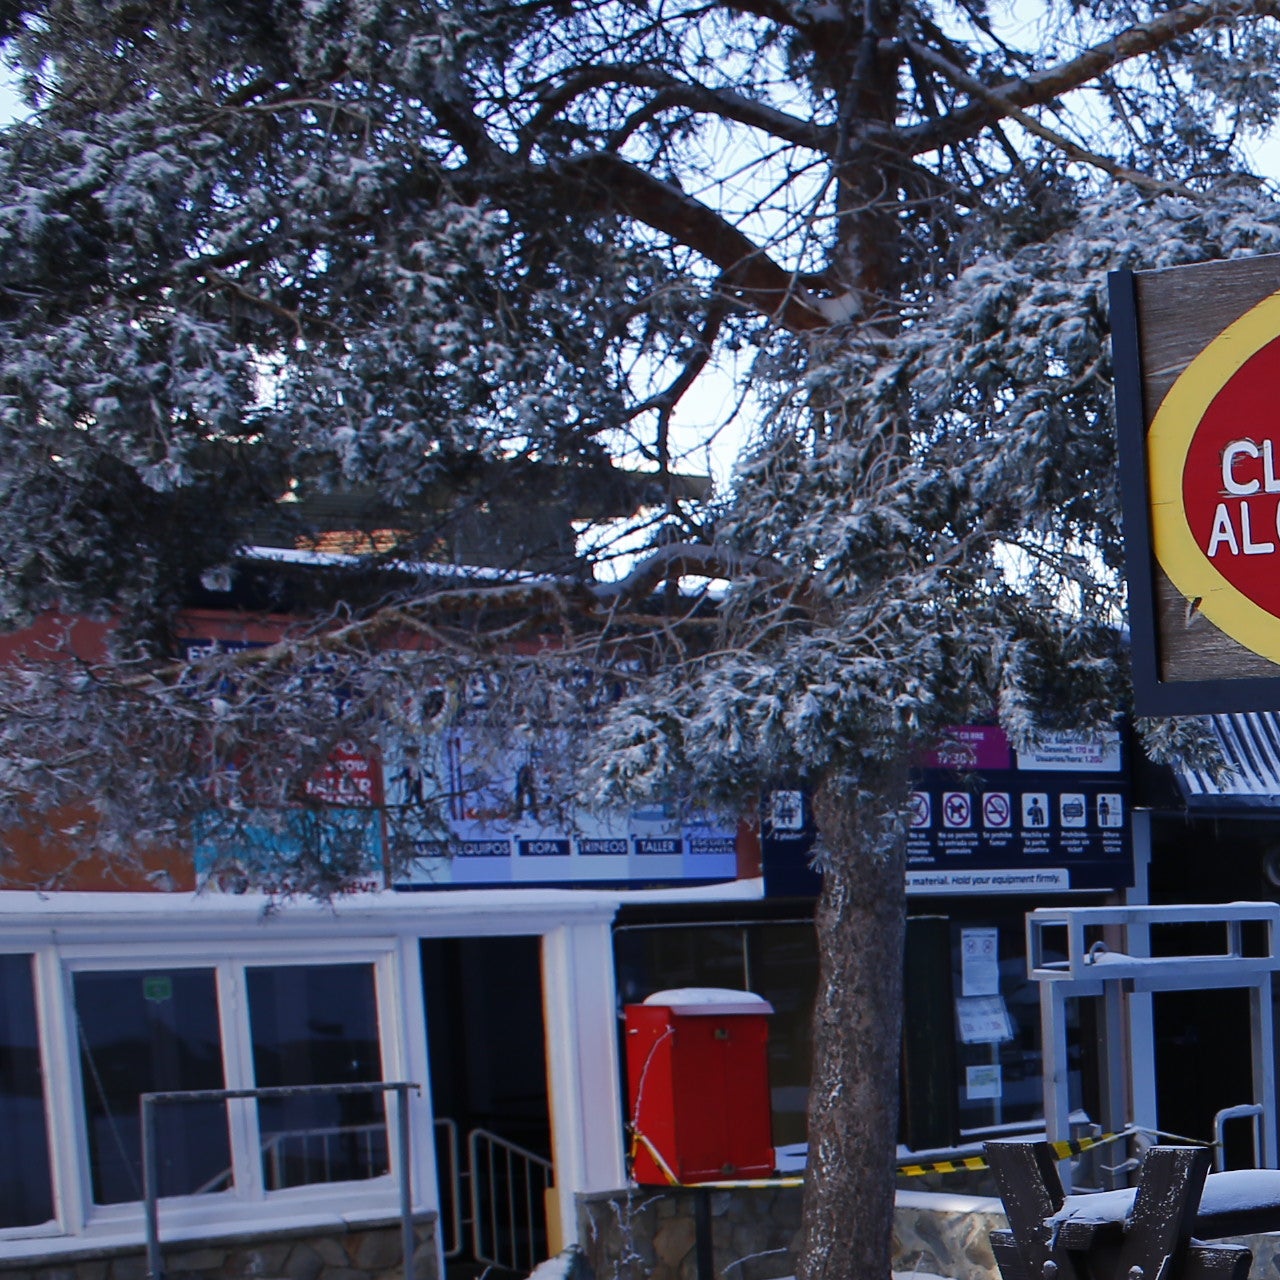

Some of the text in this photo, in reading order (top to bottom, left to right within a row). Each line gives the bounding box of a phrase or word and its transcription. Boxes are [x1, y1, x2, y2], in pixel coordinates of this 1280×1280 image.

[456, 842, 510, 856] EQUIPOS
[528, 842, 559, 854] ROPA
[580, 841, 626, 853] TRINEOS
[641, 840, 675, 852] TALLER
[952, 876, 970, 885] Hold
[972, 876, 990, 886] your
[992, 875, 1034, 885] equipment
[1036, 873, 1060, 884] firmly.
